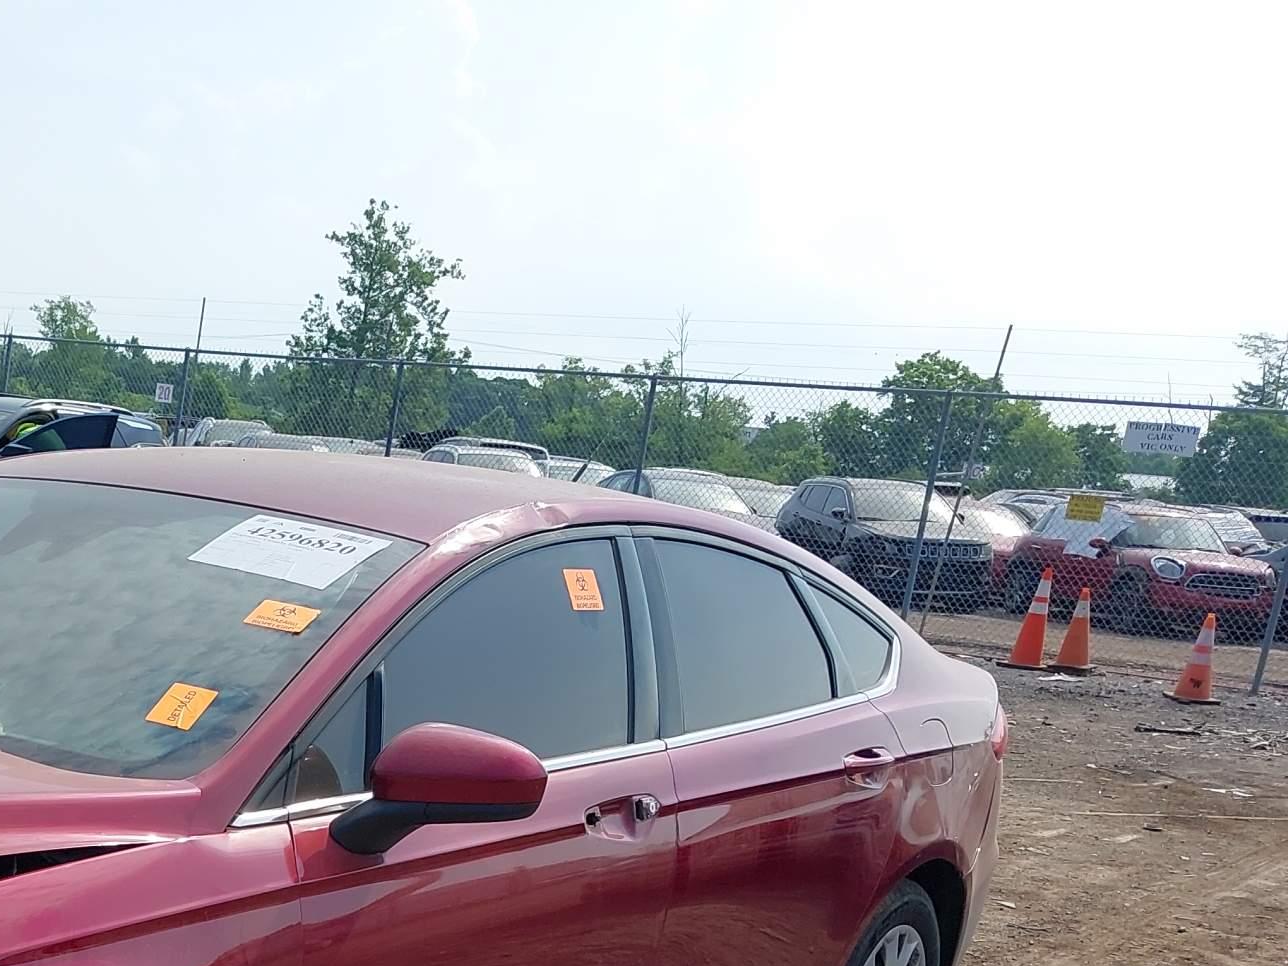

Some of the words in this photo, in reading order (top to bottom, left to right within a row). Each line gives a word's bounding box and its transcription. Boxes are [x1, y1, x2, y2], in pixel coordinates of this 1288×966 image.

[158, 385, 171, 400] 20
[1129, 422, 1199, 435] PROGRESSIVE
[1147, 432, 1174, 441] CARS
[1159, 443, 1187, 452] ONLY
[248, 526, 357, 555] 42596820
